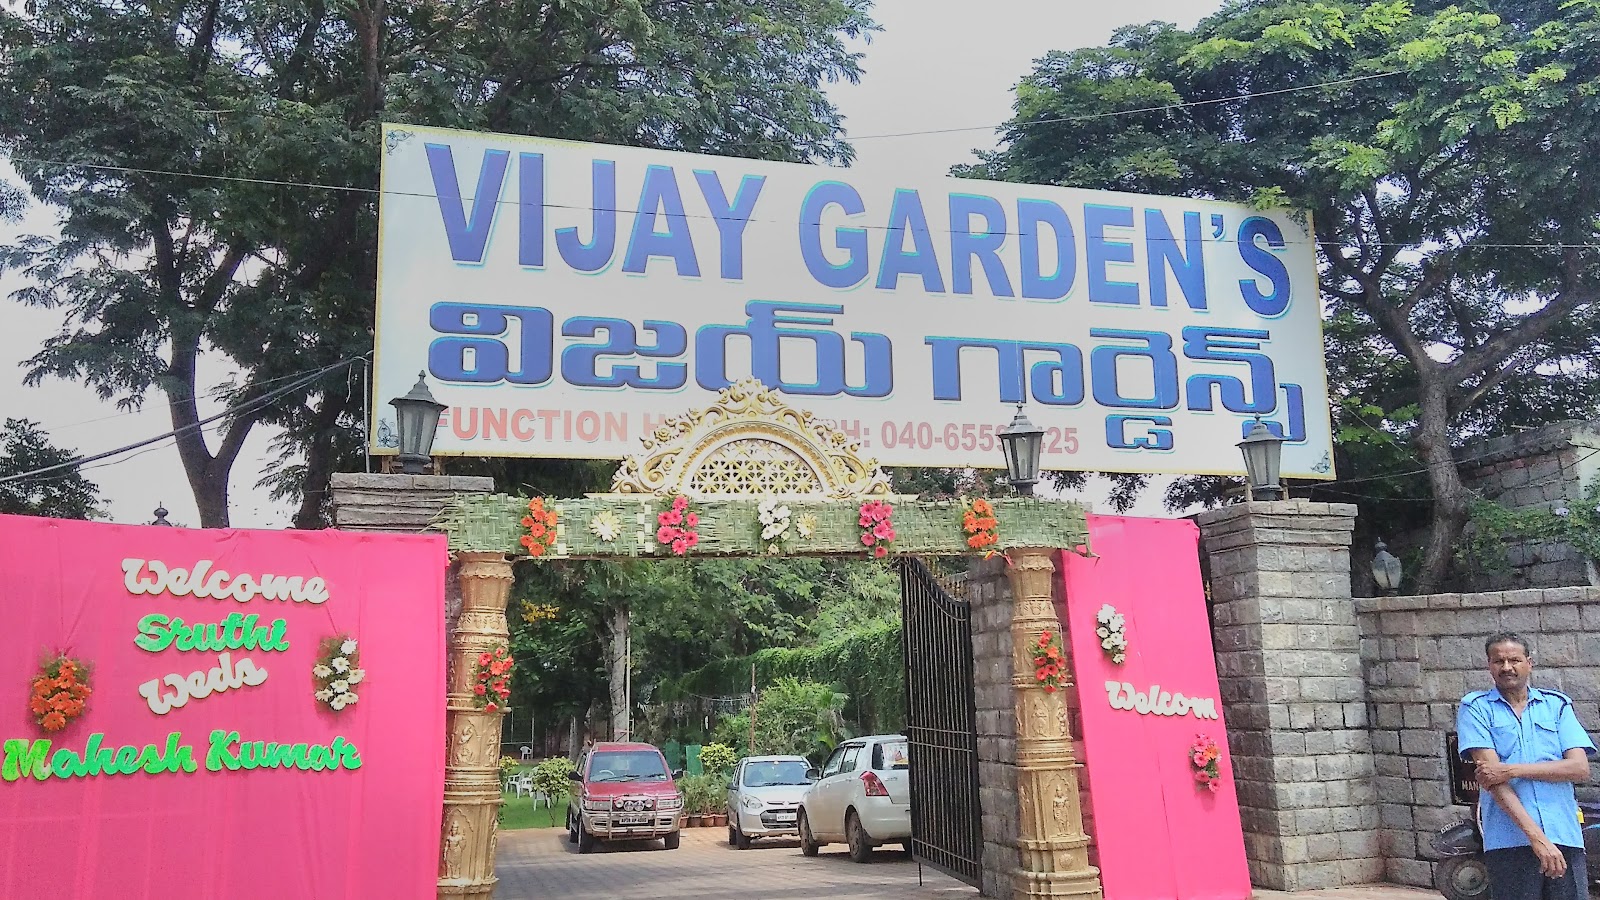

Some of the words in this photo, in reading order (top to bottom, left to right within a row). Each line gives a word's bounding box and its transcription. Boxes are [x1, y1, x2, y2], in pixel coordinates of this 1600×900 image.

[424, 142, 767, 282] VIJAY
[800, 180, 1292, 317] GARDEN'S
[429, 300, 893, 398] విజయ్
[881, 421, 1079, 455] 040-65525
[121, 558, 329, 604] Welcome
[134, 613, 289, 652] Sruthi
[139, 652, 268, 715] Weds
[1105, 681, 1219, 720] Welcom
[1, 732, 198, 782] Mahesh
[206, 730, 362, 772] Kumar
